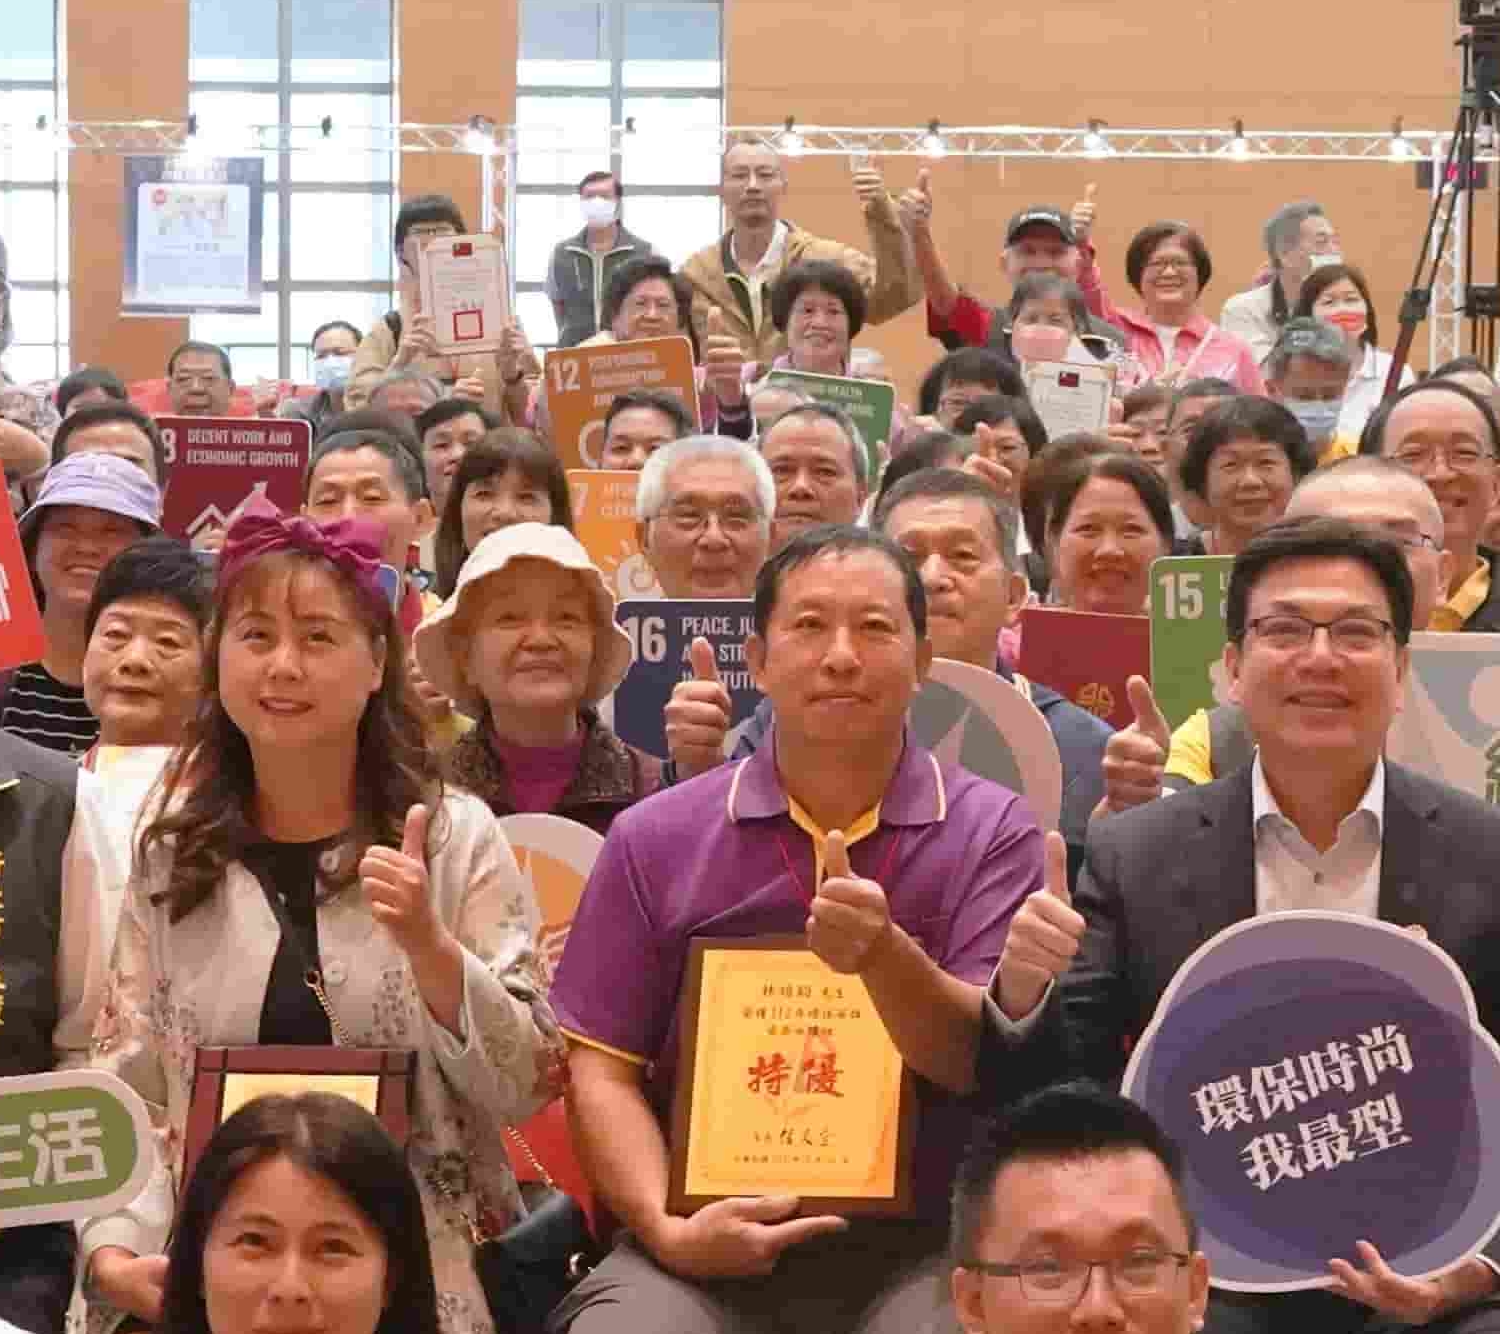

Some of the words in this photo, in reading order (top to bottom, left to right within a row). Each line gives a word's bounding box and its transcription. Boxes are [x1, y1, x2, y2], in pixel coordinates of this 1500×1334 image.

[549, 359, 581, 395] 12
[186, 449, 248, 467] ECONOMIC
[249, 451, 299, 468] GROWTH
[187, 428, 229, 444] DECENT
[231, 430, 264, 444] WORK
[267, 431, 293, 446] AND
[1156, 571, 1203, 620] 15
[621, 616, 667, 662] 16
[1190, 1024, 1414, 1136] 環保時尚
[1239, 1091, 1413, 1191] 我最型
